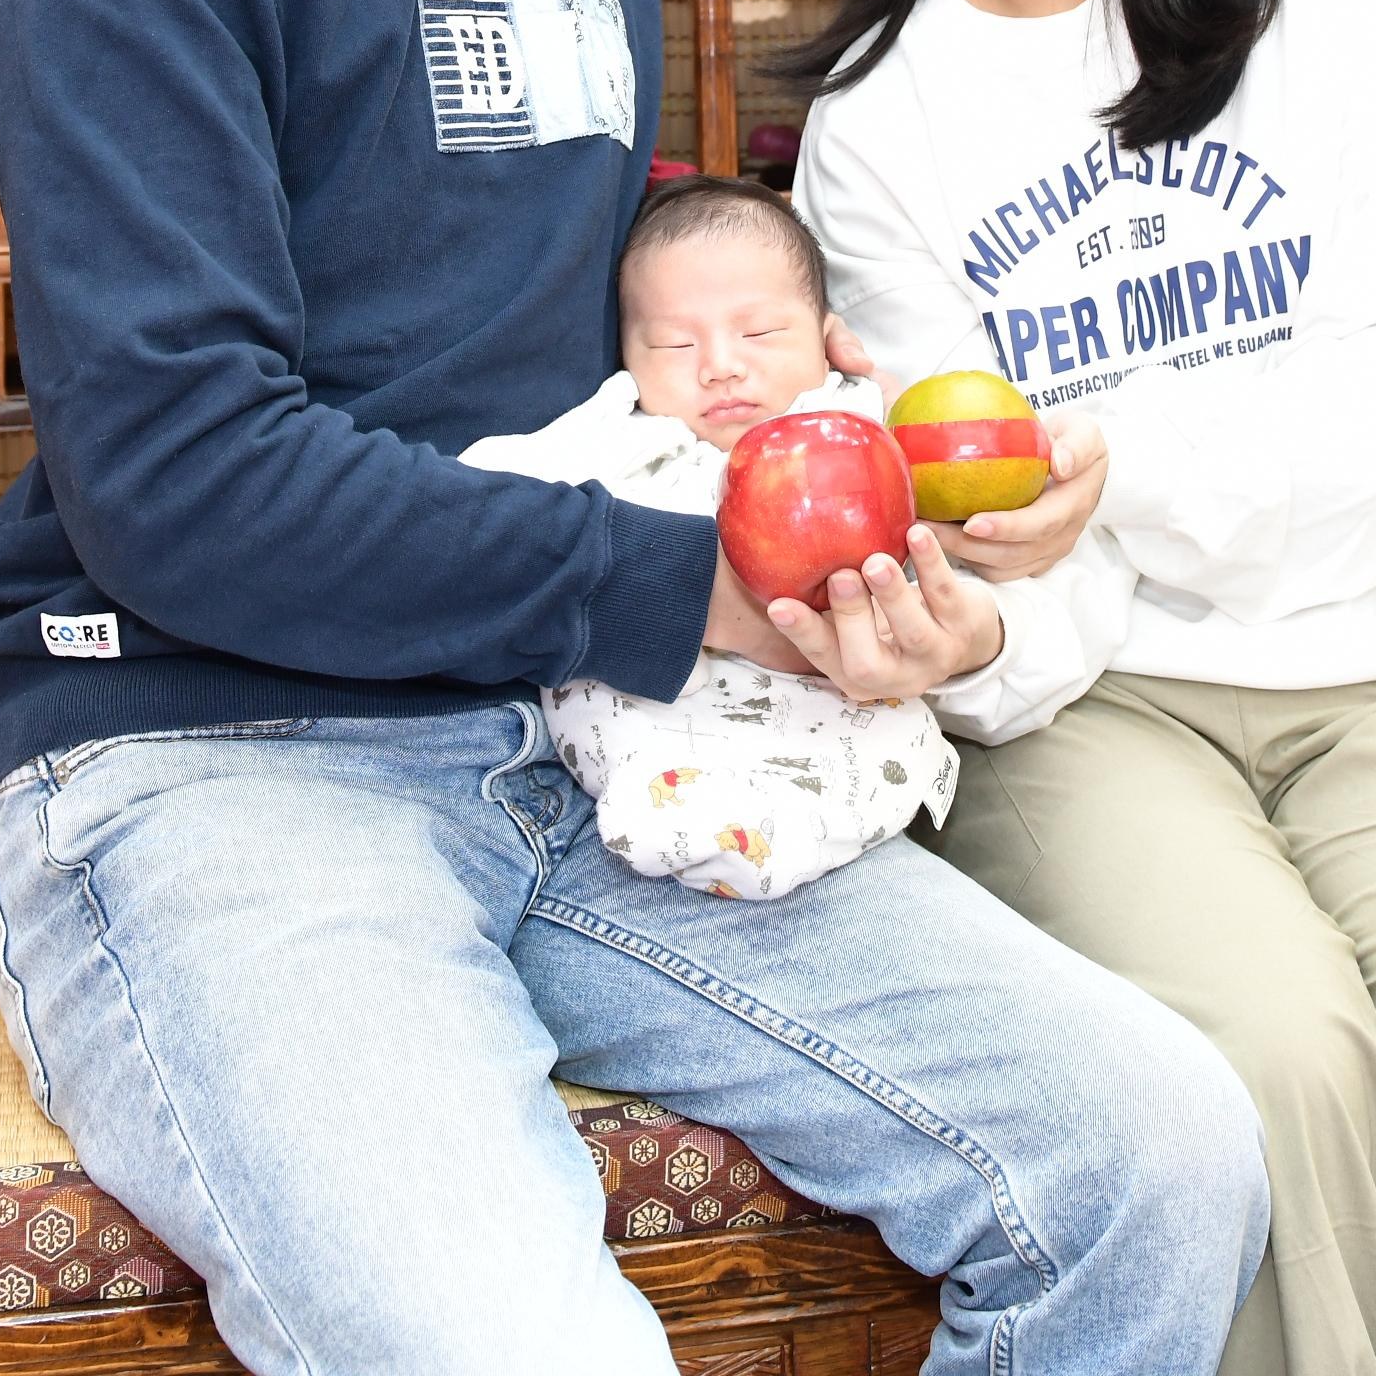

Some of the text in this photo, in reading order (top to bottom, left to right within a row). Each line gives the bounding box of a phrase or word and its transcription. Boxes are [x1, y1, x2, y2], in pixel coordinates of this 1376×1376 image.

[963, 127, 1286, 298] MICHAEL SCOTT
[1116, 235, 1312, 356] COMPANY
[1212, 340, 1234, 360] WE
